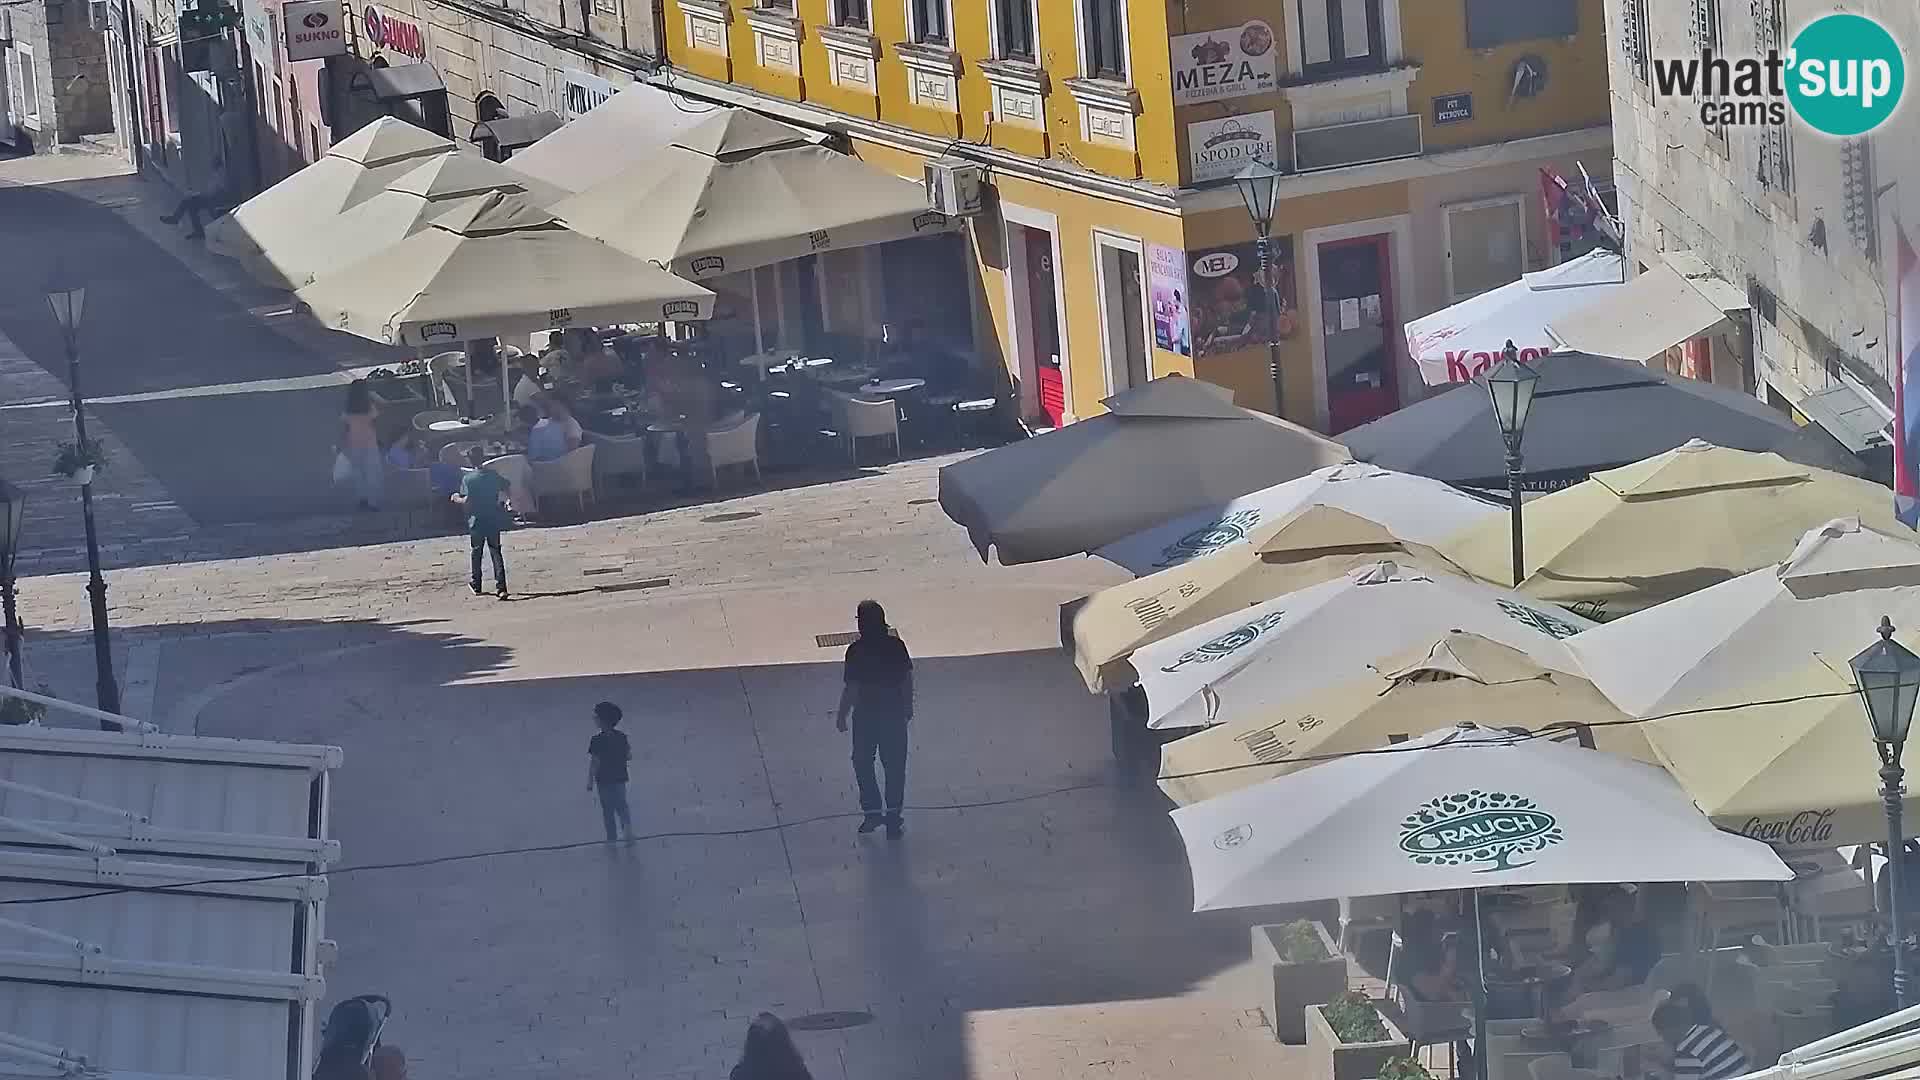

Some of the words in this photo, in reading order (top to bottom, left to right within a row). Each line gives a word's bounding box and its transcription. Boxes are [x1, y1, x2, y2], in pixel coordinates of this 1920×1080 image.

[295, 30, 340, 44] SUKNO
[381, 14, 421, 54] SUKNO
[1176, 61, 1255, 91] MEZA
[1226, 82, 1247, 93] GRILL
[1194, 147, 1241, 165] ISPOD
[1440, 815, 1538, 845] RAUCH
